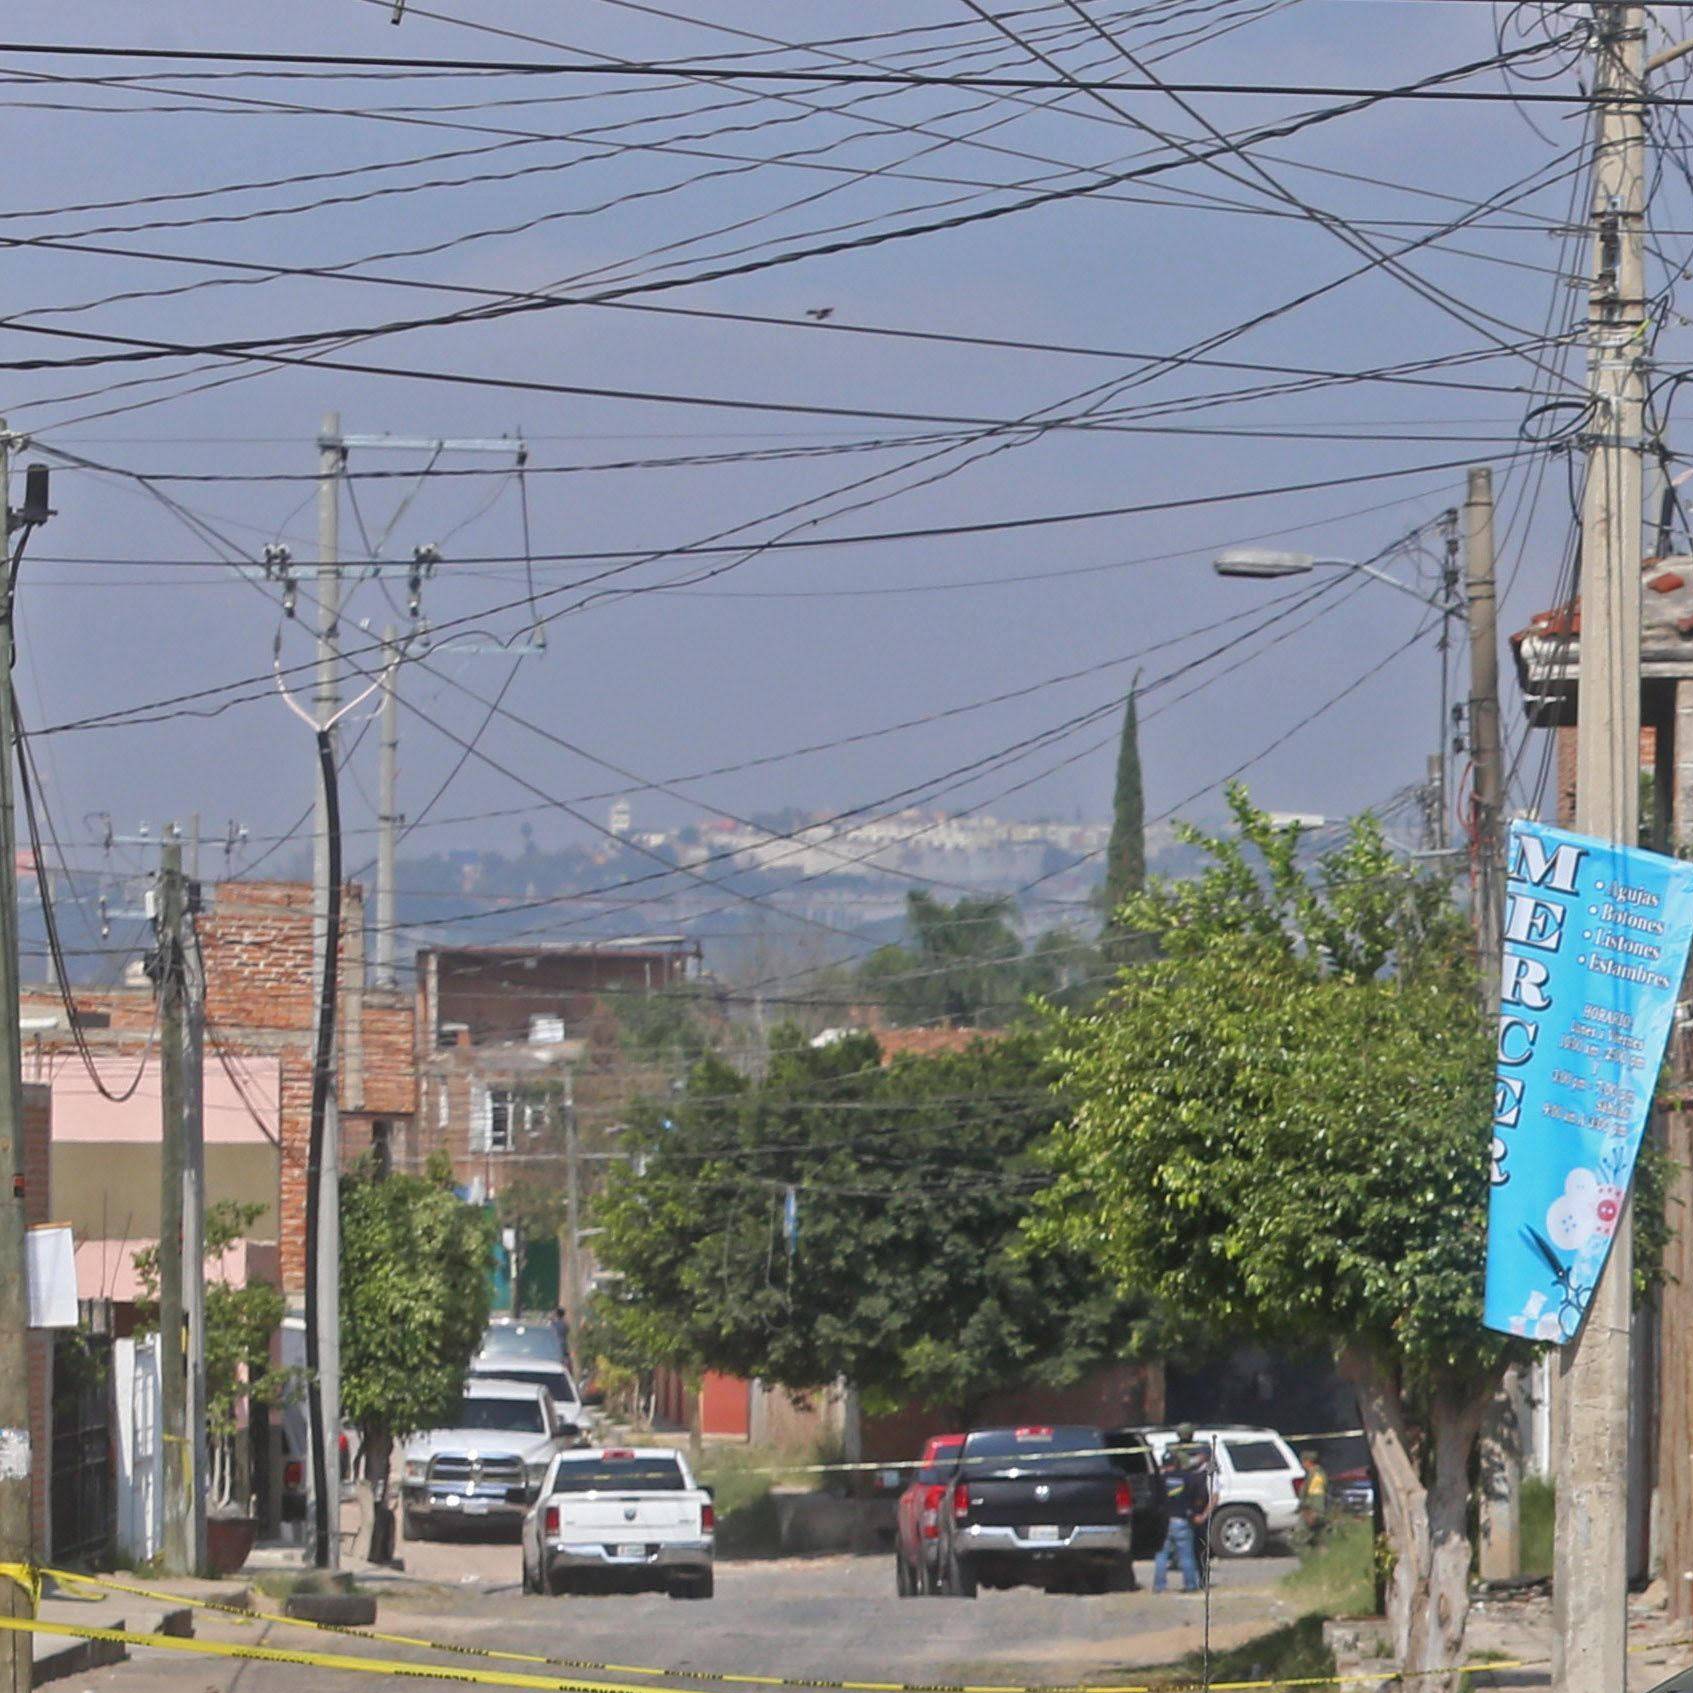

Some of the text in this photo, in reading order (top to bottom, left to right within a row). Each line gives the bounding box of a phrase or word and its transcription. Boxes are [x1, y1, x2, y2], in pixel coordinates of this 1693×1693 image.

[1607, 881, 1661, 907] Agujas
[1601, 903, 1665, 934] Botones
[1594, 928, 1662, 960] Listones
[1587, 952, 1671, 988] Estambres
